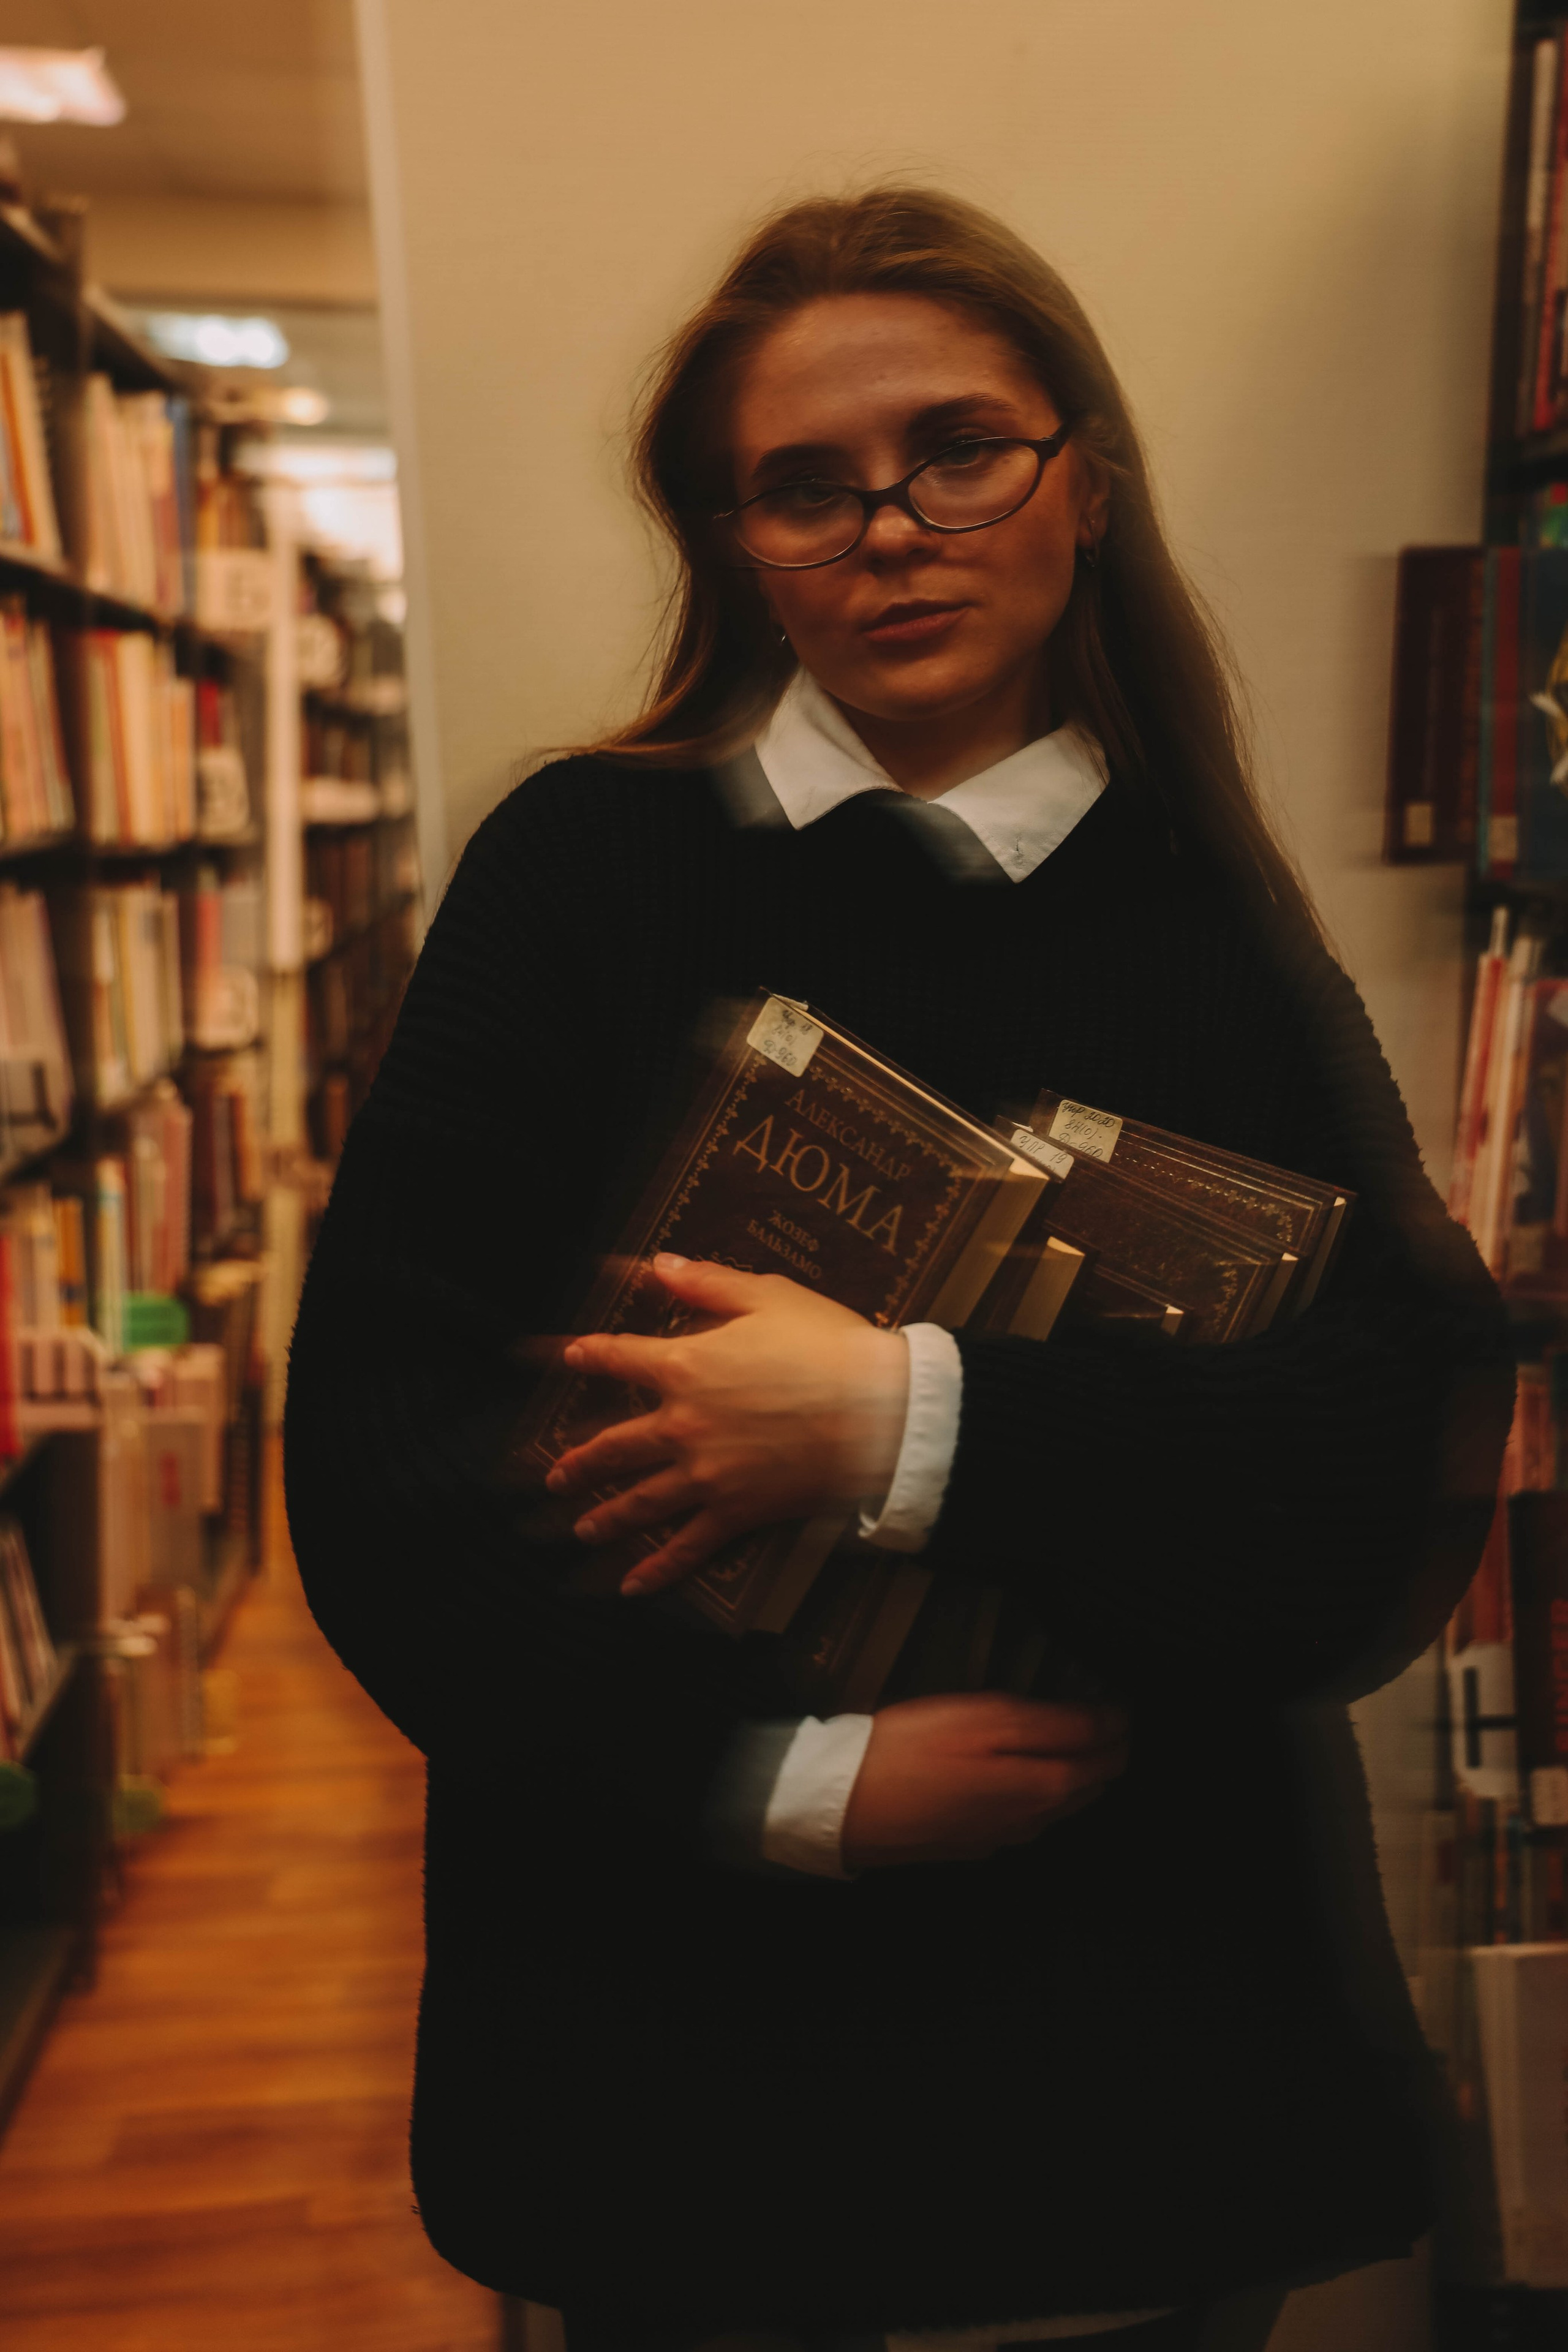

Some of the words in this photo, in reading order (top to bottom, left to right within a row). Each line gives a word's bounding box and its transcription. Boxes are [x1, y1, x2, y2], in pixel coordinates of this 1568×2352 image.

[783, 1088, 912, 1182] АЛЕКСАНДР
[733, 1114, 903, 1257] ДЮМА
[747, 1218, 823, 1280] БАЛЬЗАМО
[767, 1209, 820, 1253] ЖОЗЕФ
